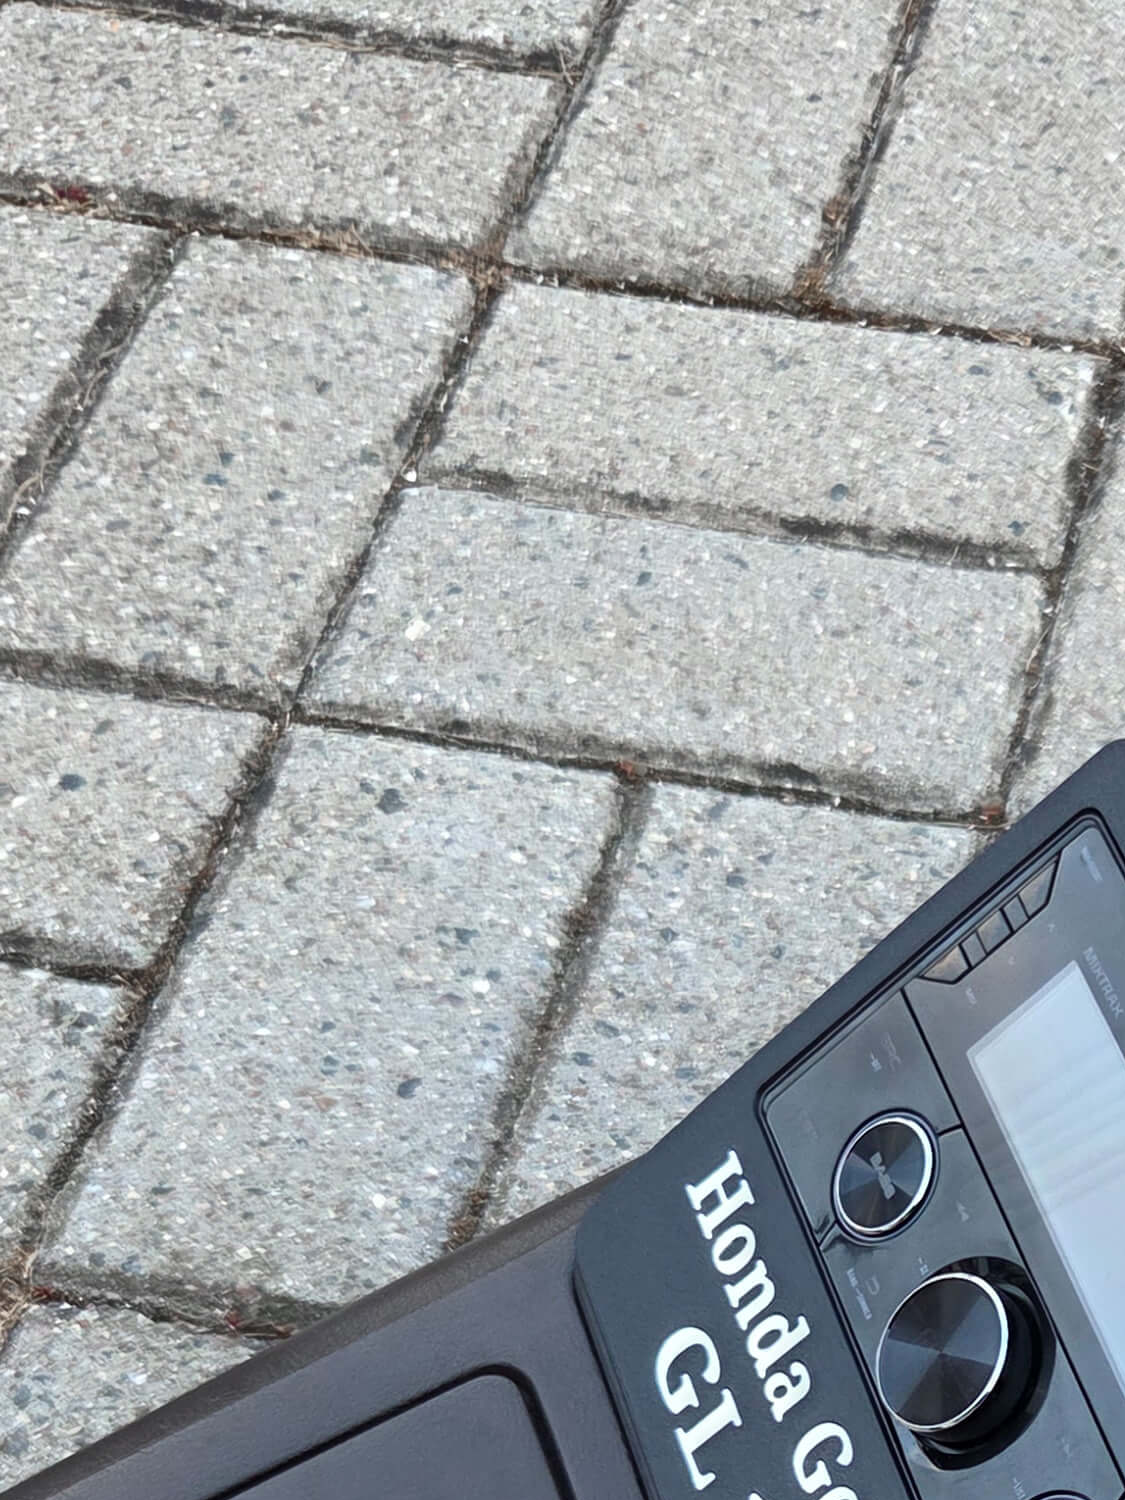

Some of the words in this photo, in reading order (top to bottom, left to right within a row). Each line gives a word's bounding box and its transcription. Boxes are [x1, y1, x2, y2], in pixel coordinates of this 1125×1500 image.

[1083, 946, 1123, 1021] MIXTRAX
[686, 1151, 810, 1422] Honda
[656, 1328, 741, 1490] GL
